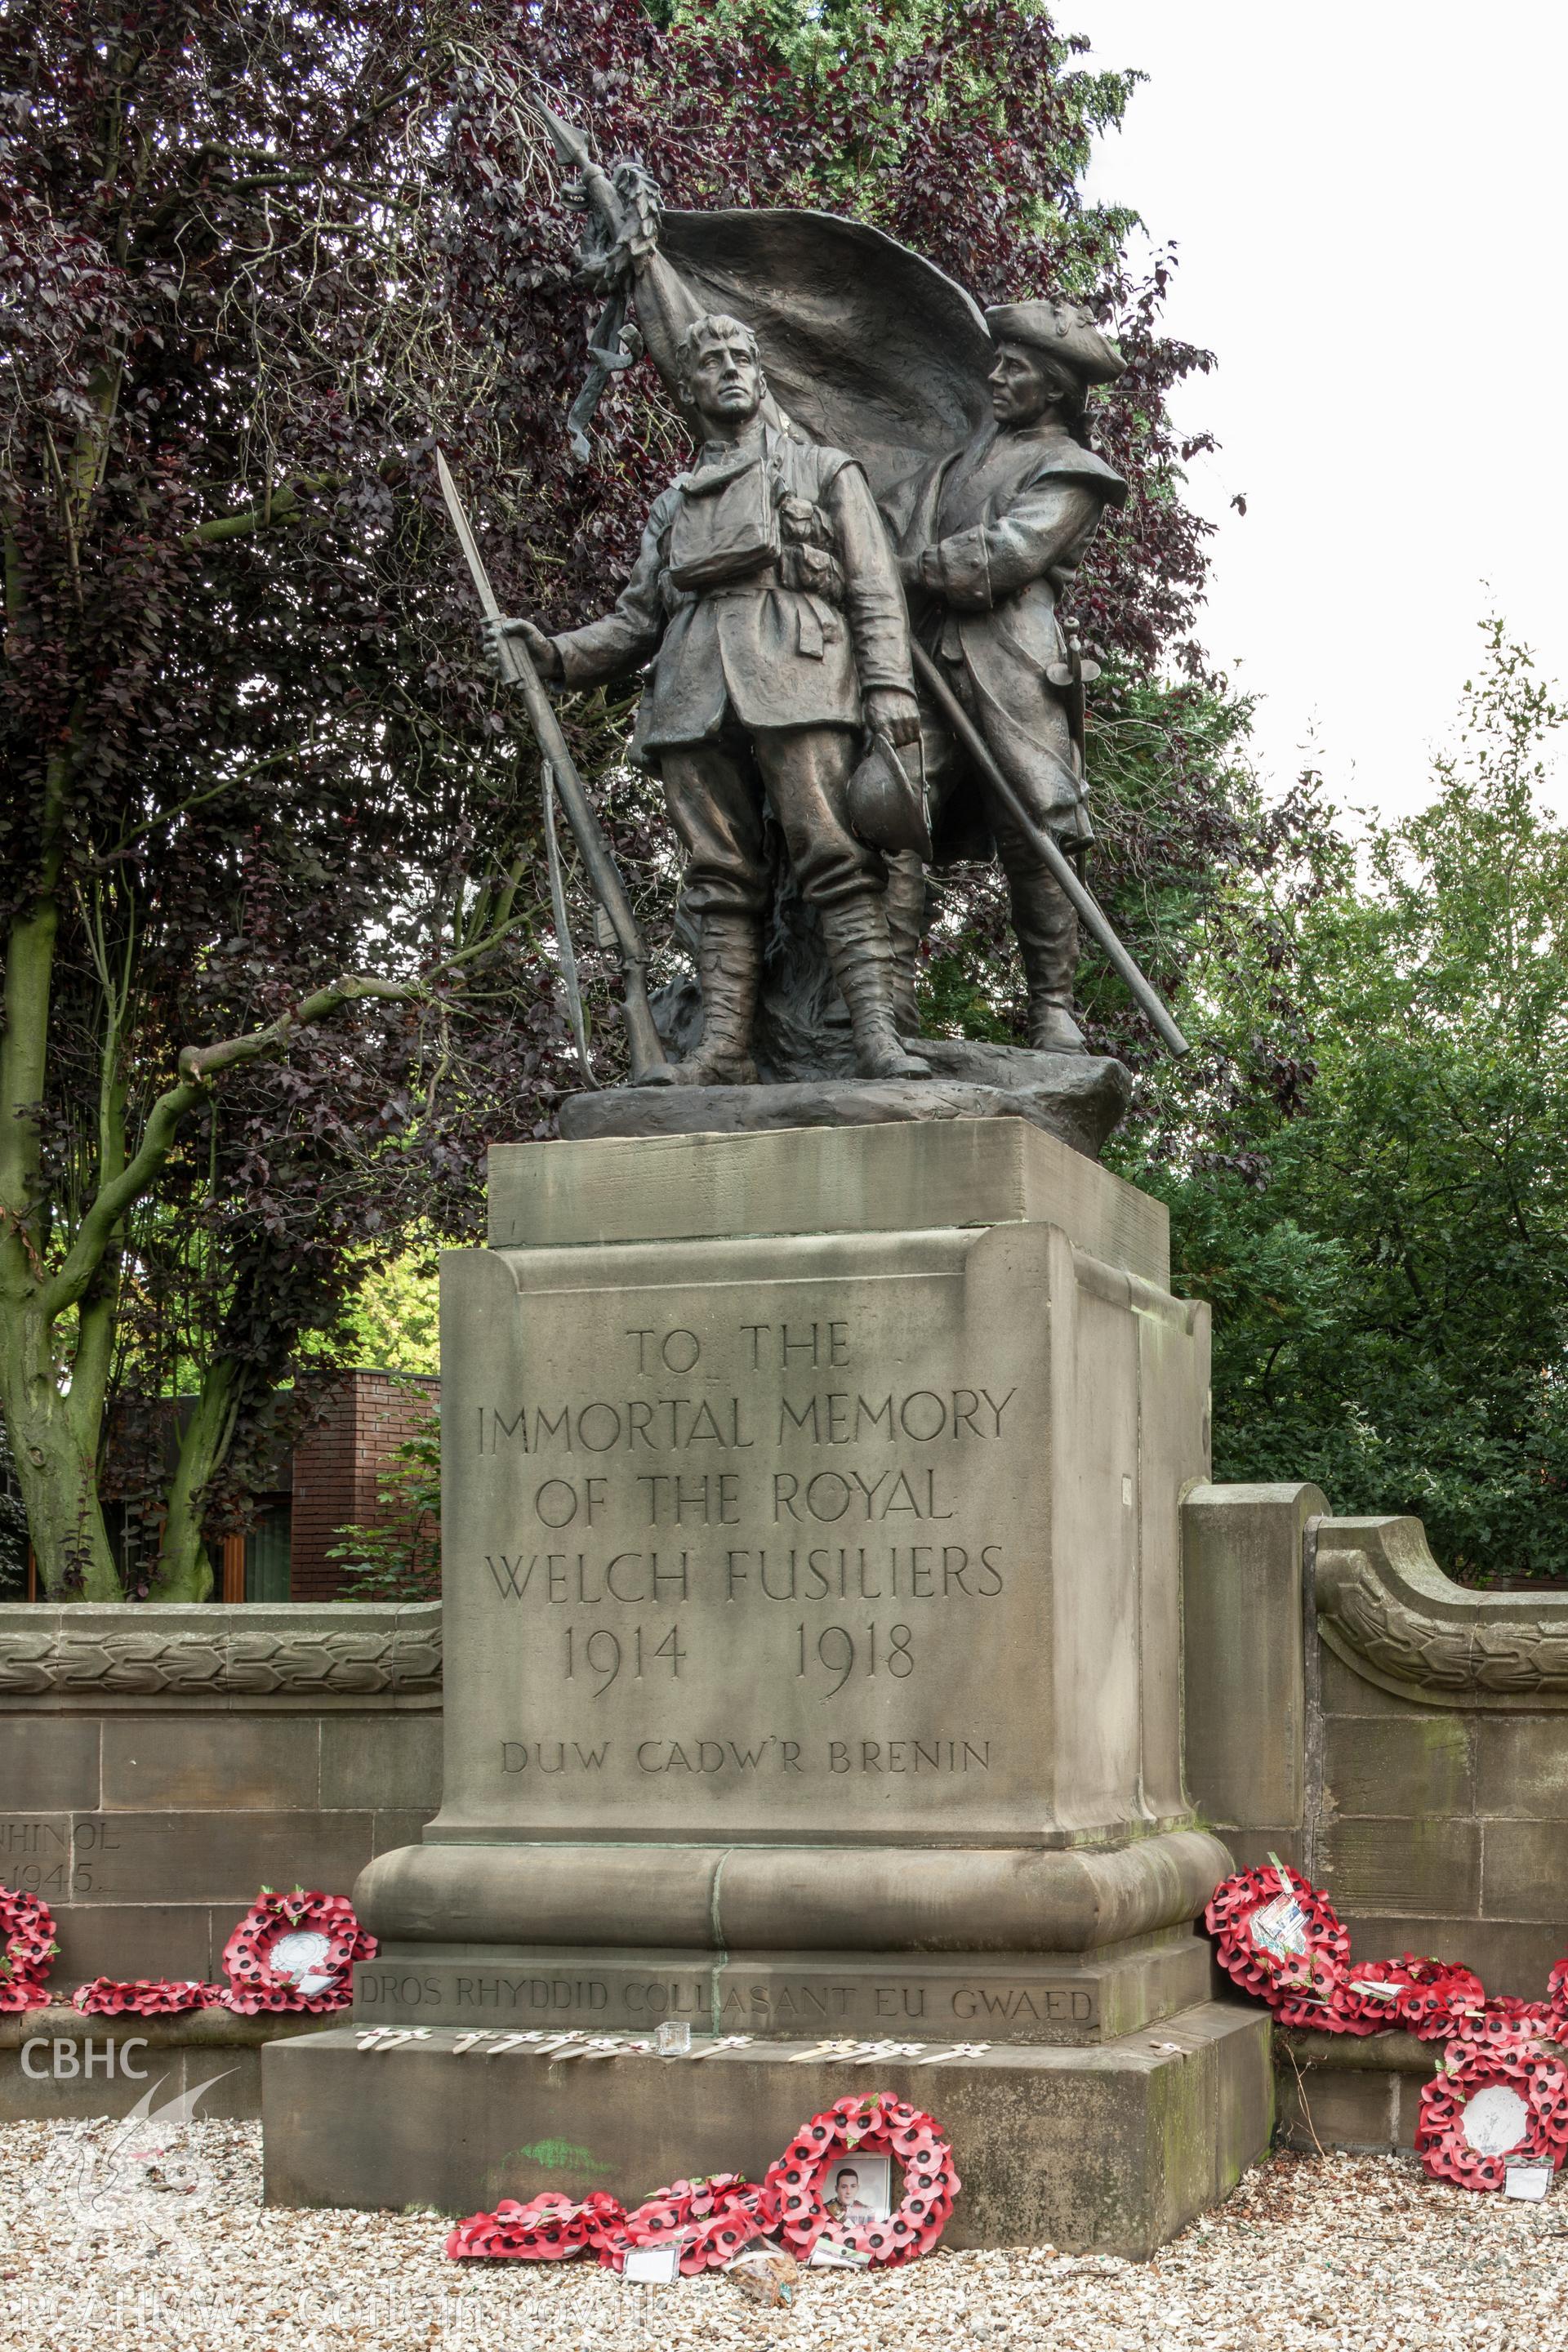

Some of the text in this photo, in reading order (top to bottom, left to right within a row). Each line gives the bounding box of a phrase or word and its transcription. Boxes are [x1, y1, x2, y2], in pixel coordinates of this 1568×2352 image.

[627, 1321, 850, 1377] TO THE
[477, 1388, 1018, 1455] IMMORTAL MEMORY
[534, 1469, 953, 1529] OF THE ROYAL
[484, 1545, 1004, 1605] WELCH FUSILIERS
[564, 1621, 915, 1701] 1914 1918
[501, 1735, 991, 1775] DUW CADW'R BRENIN
[0, 1823, 121, 1852] HINOL
[359, 1976, 1092, 2020] DROS RHYDDID COLLASANT EU GWAED
